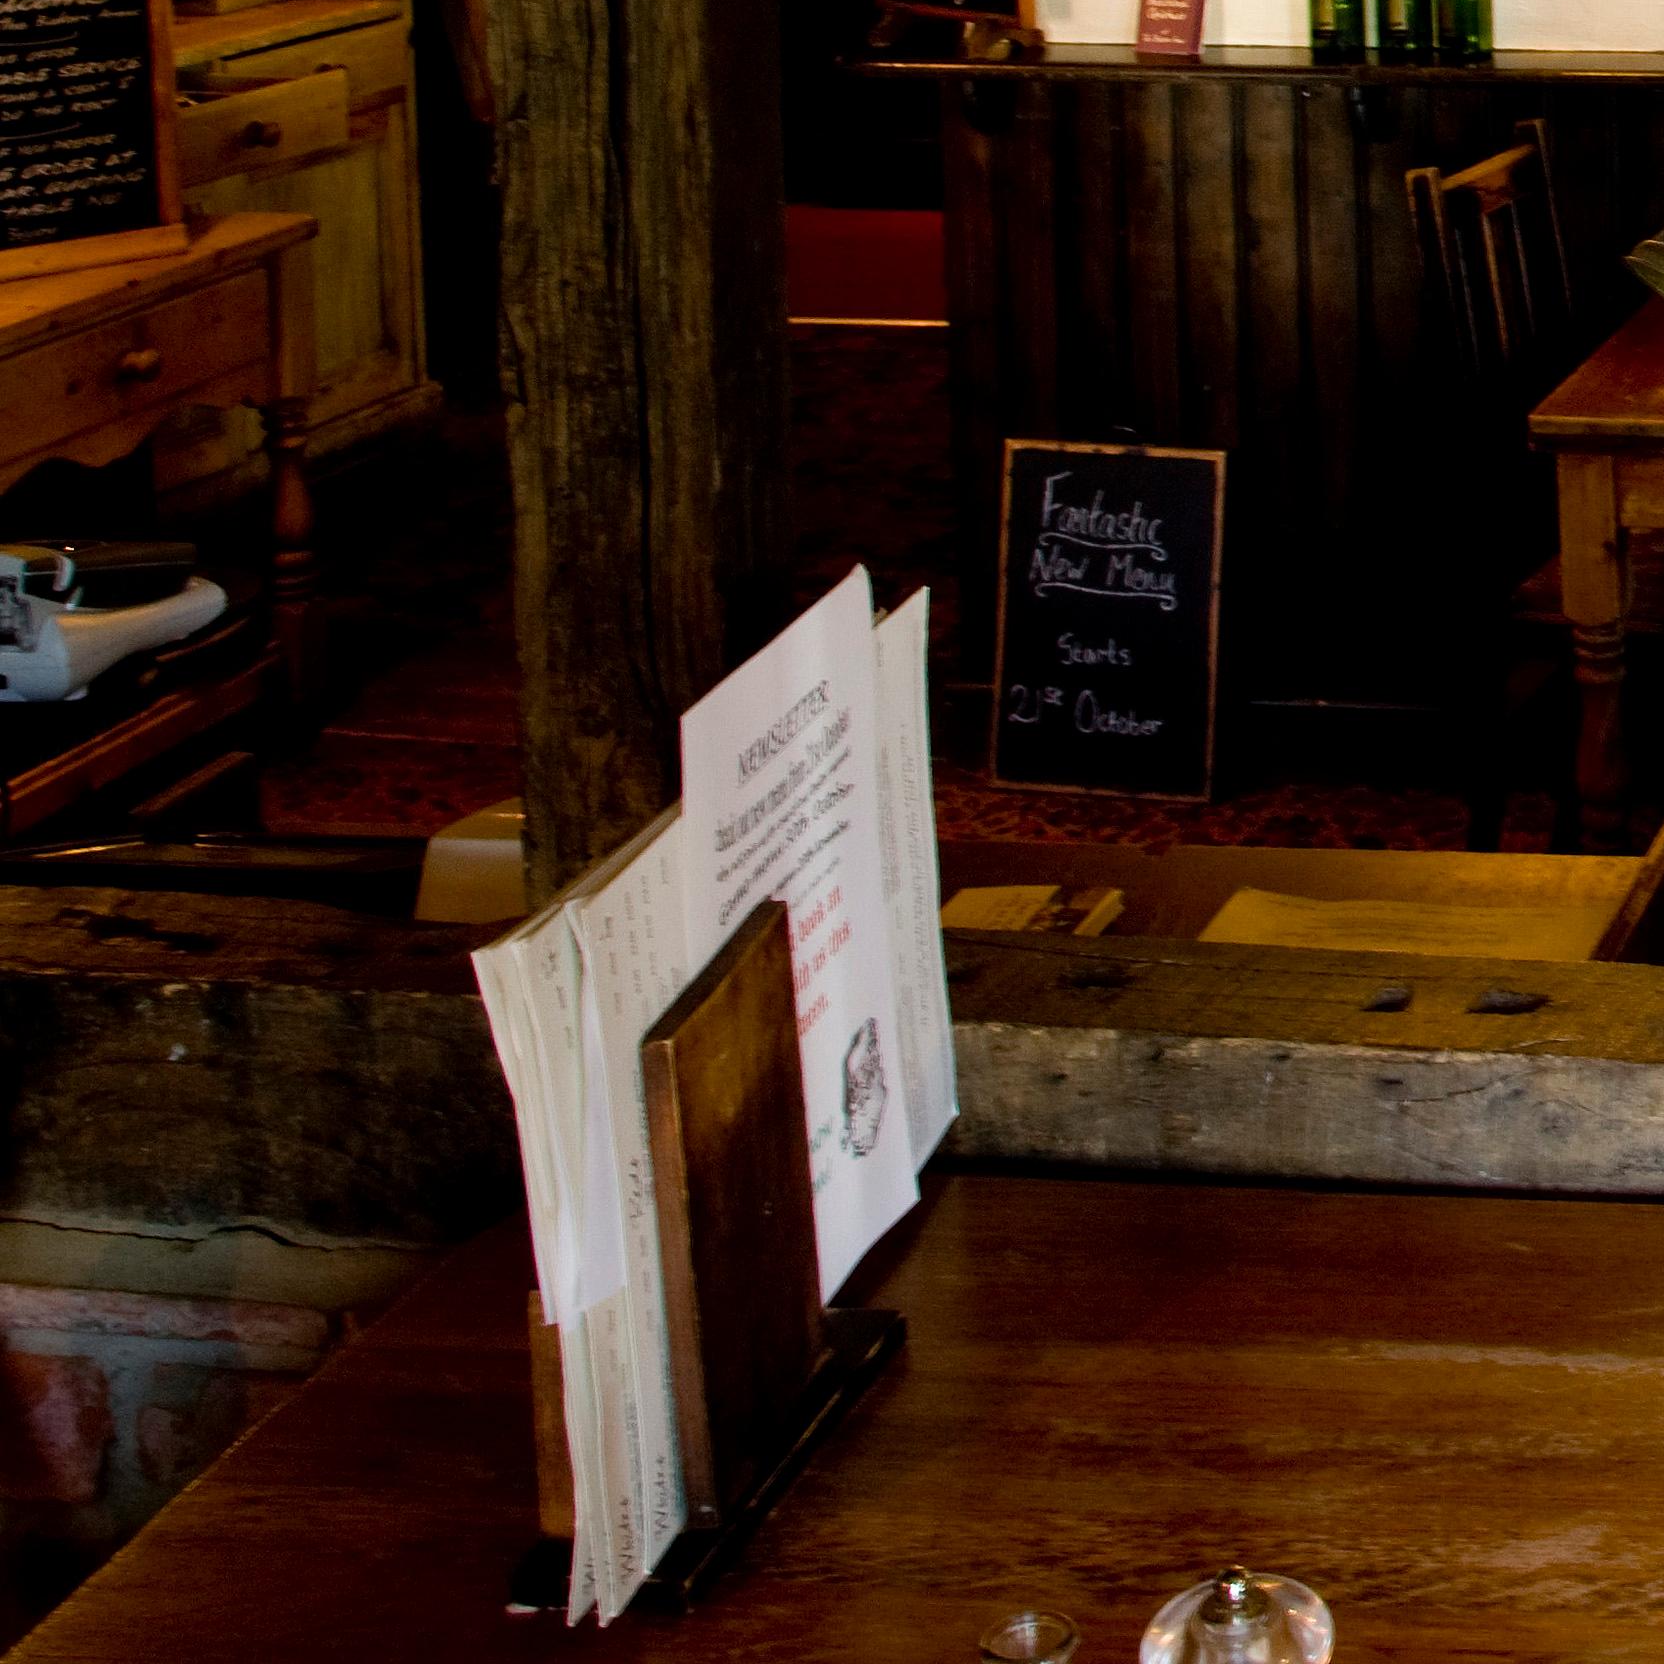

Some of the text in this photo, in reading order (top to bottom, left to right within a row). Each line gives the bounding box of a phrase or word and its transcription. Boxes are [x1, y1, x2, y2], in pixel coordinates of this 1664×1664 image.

[1041, 470, 1163, 545] Fantastic
[1029, 544, 1177, 594] New Menu
[1057, 631, 1132, 666] Starts
[738, 678, 830, 785] NEWSLETTER
[1074, 688, 1163, 736] October
